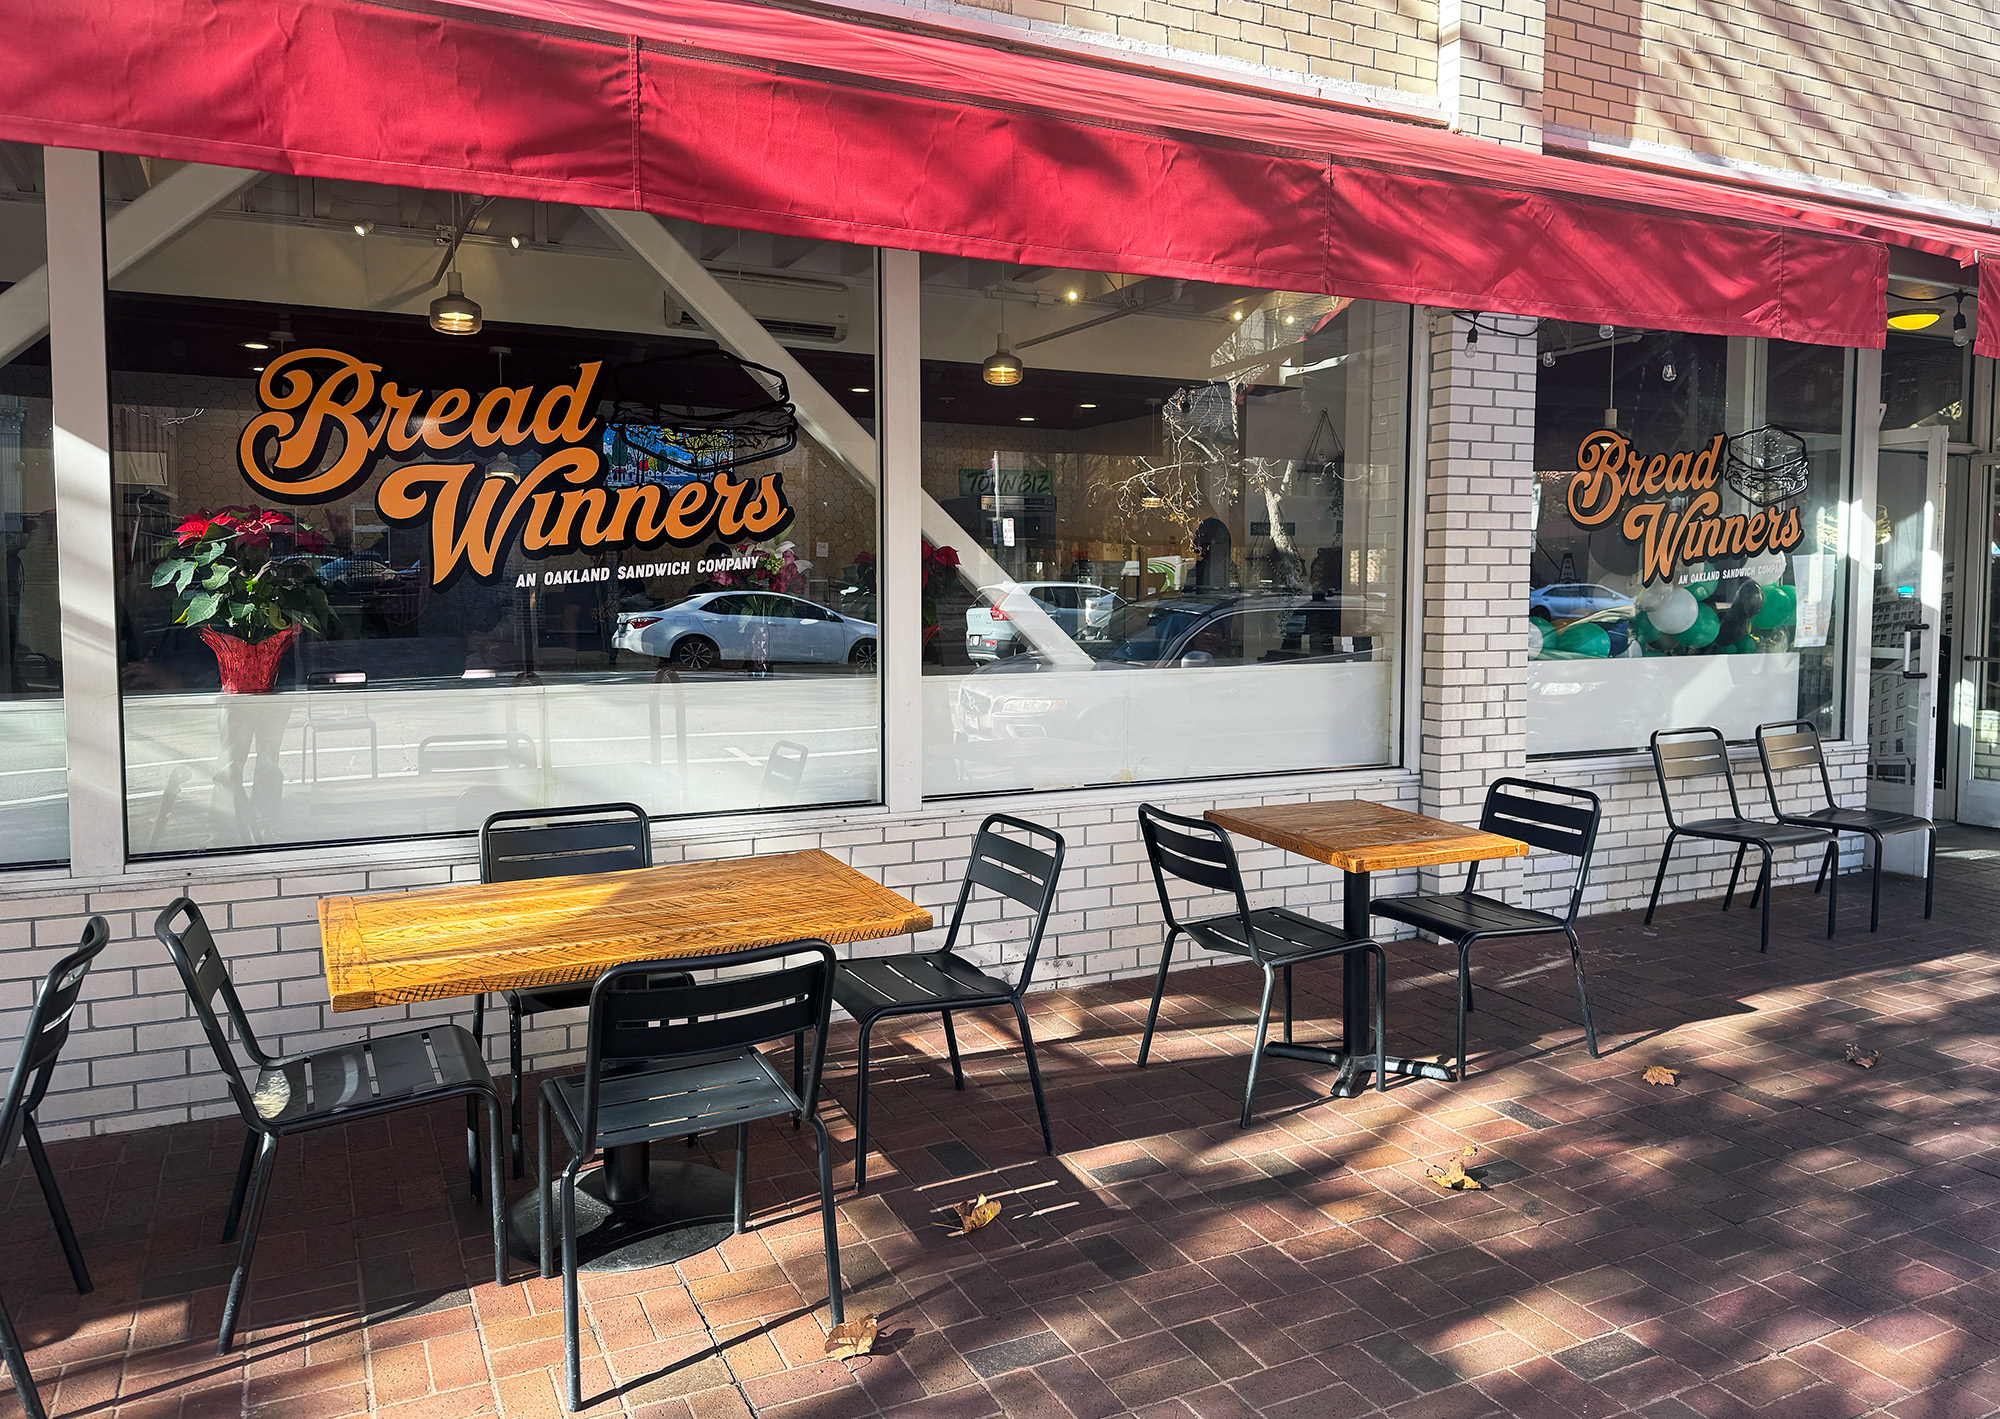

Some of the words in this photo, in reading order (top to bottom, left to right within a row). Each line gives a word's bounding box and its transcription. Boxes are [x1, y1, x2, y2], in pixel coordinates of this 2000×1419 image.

[238, 347, 606, 497] Bread
[376, 447, 790, 586] Winners
[1018, 473, 1050, 493] BIZ
[1567, 429, 1726, 525] Bread
[515, 573, 537, 588] AN
[544, 567, 610, 586] OAKLAND
[617, 561, 691, 580] SANDWICH
[696, 555, 760, 574] COMPANY
[1622, 490, 1802, 584] Winners
[1678, 574, 1689, 585] AN
[1690, 570, 1721, 584] OAKLAND
[1722, 567, 1756, 579] SANDWICH
